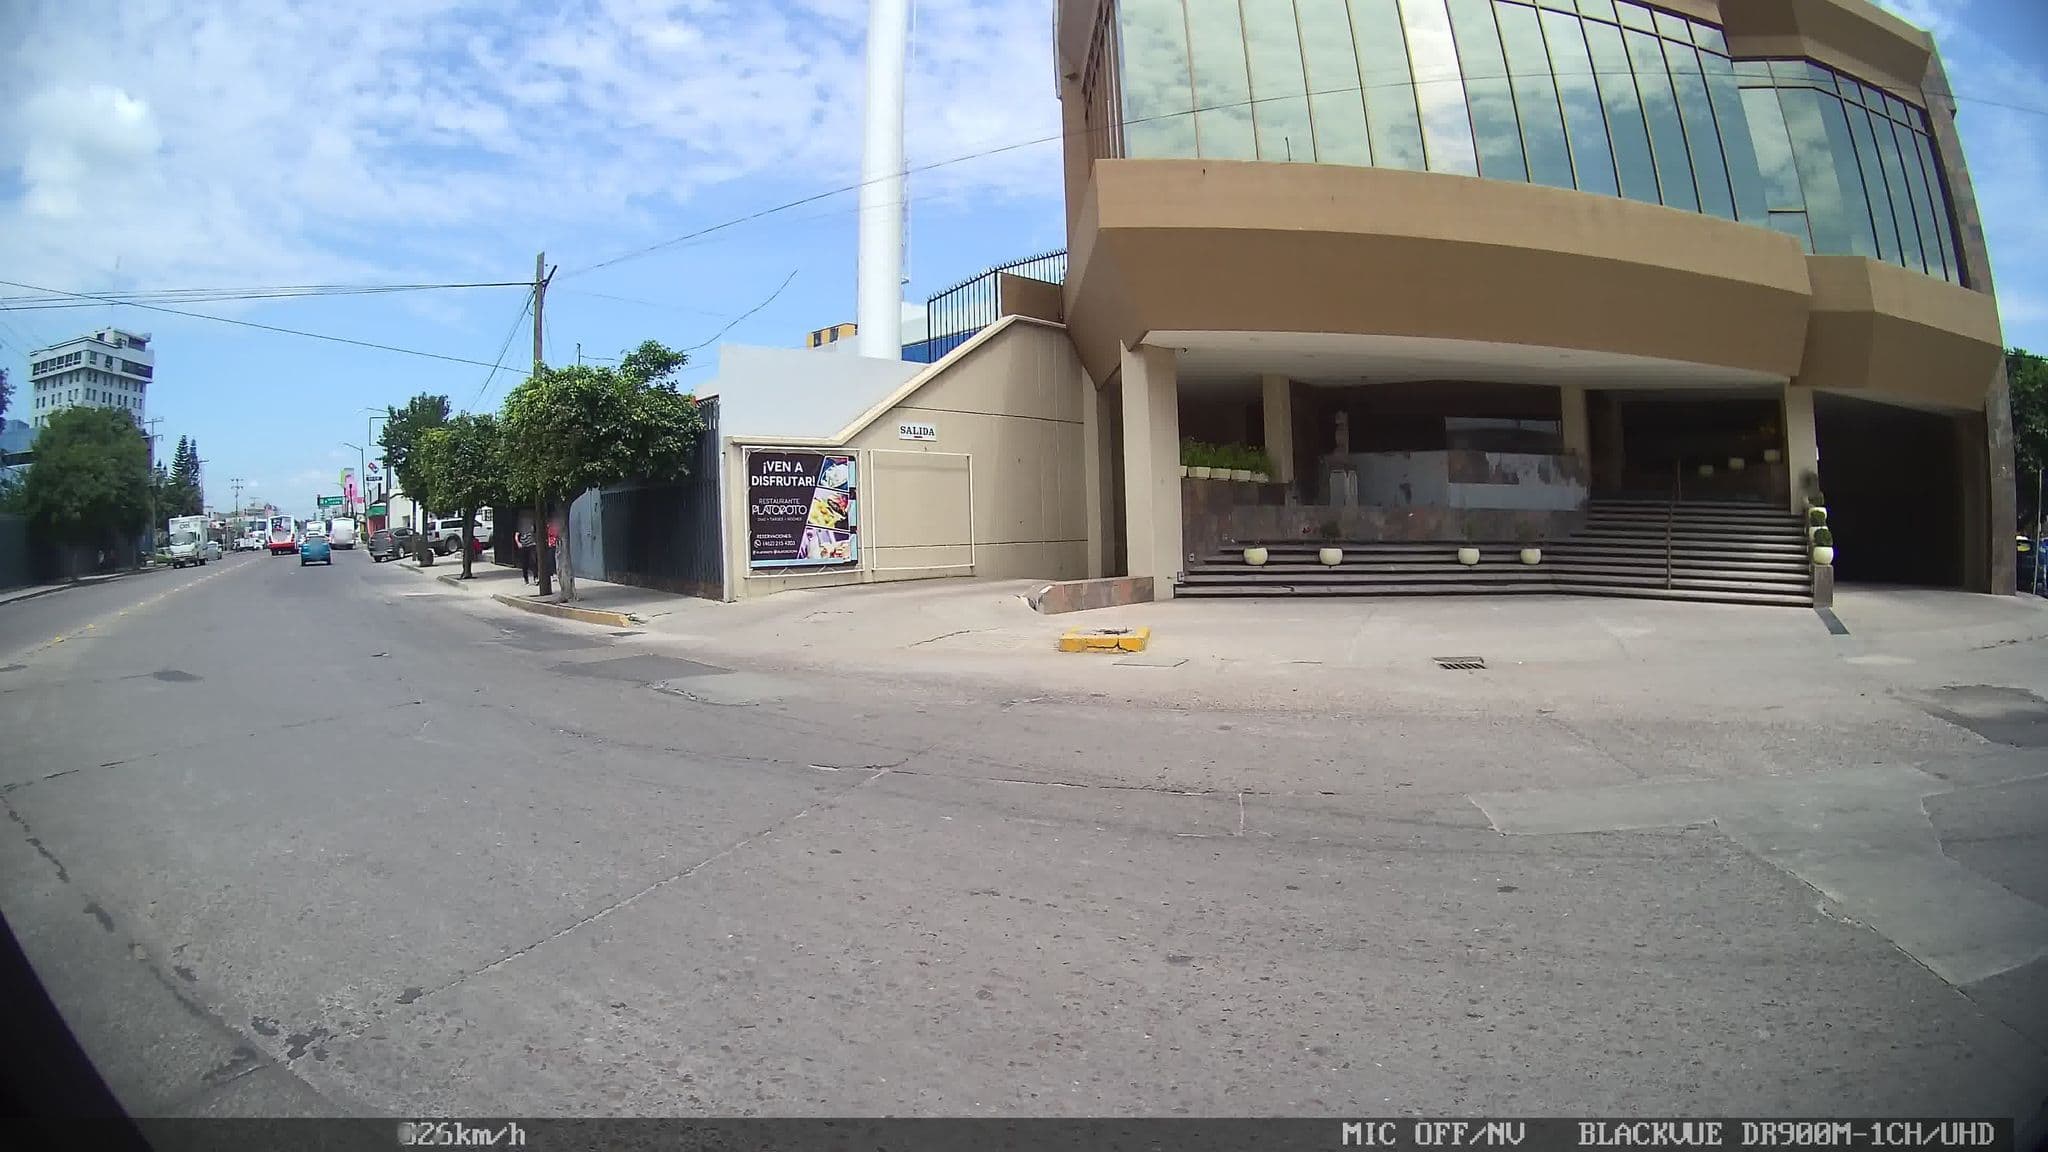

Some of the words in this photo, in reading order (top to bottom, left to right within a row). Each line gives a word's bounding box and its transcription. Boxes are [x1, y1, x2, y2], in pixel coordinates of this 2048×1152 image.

[900, 425, 935, 436] SALIDA
[763, 461, 792, 475] ¡VEN
[794, 462, 804, 473] A
[751, 475, 816, 487] DISFRUTAR!
[752, 504, 808, 515] PLATOPOTO
